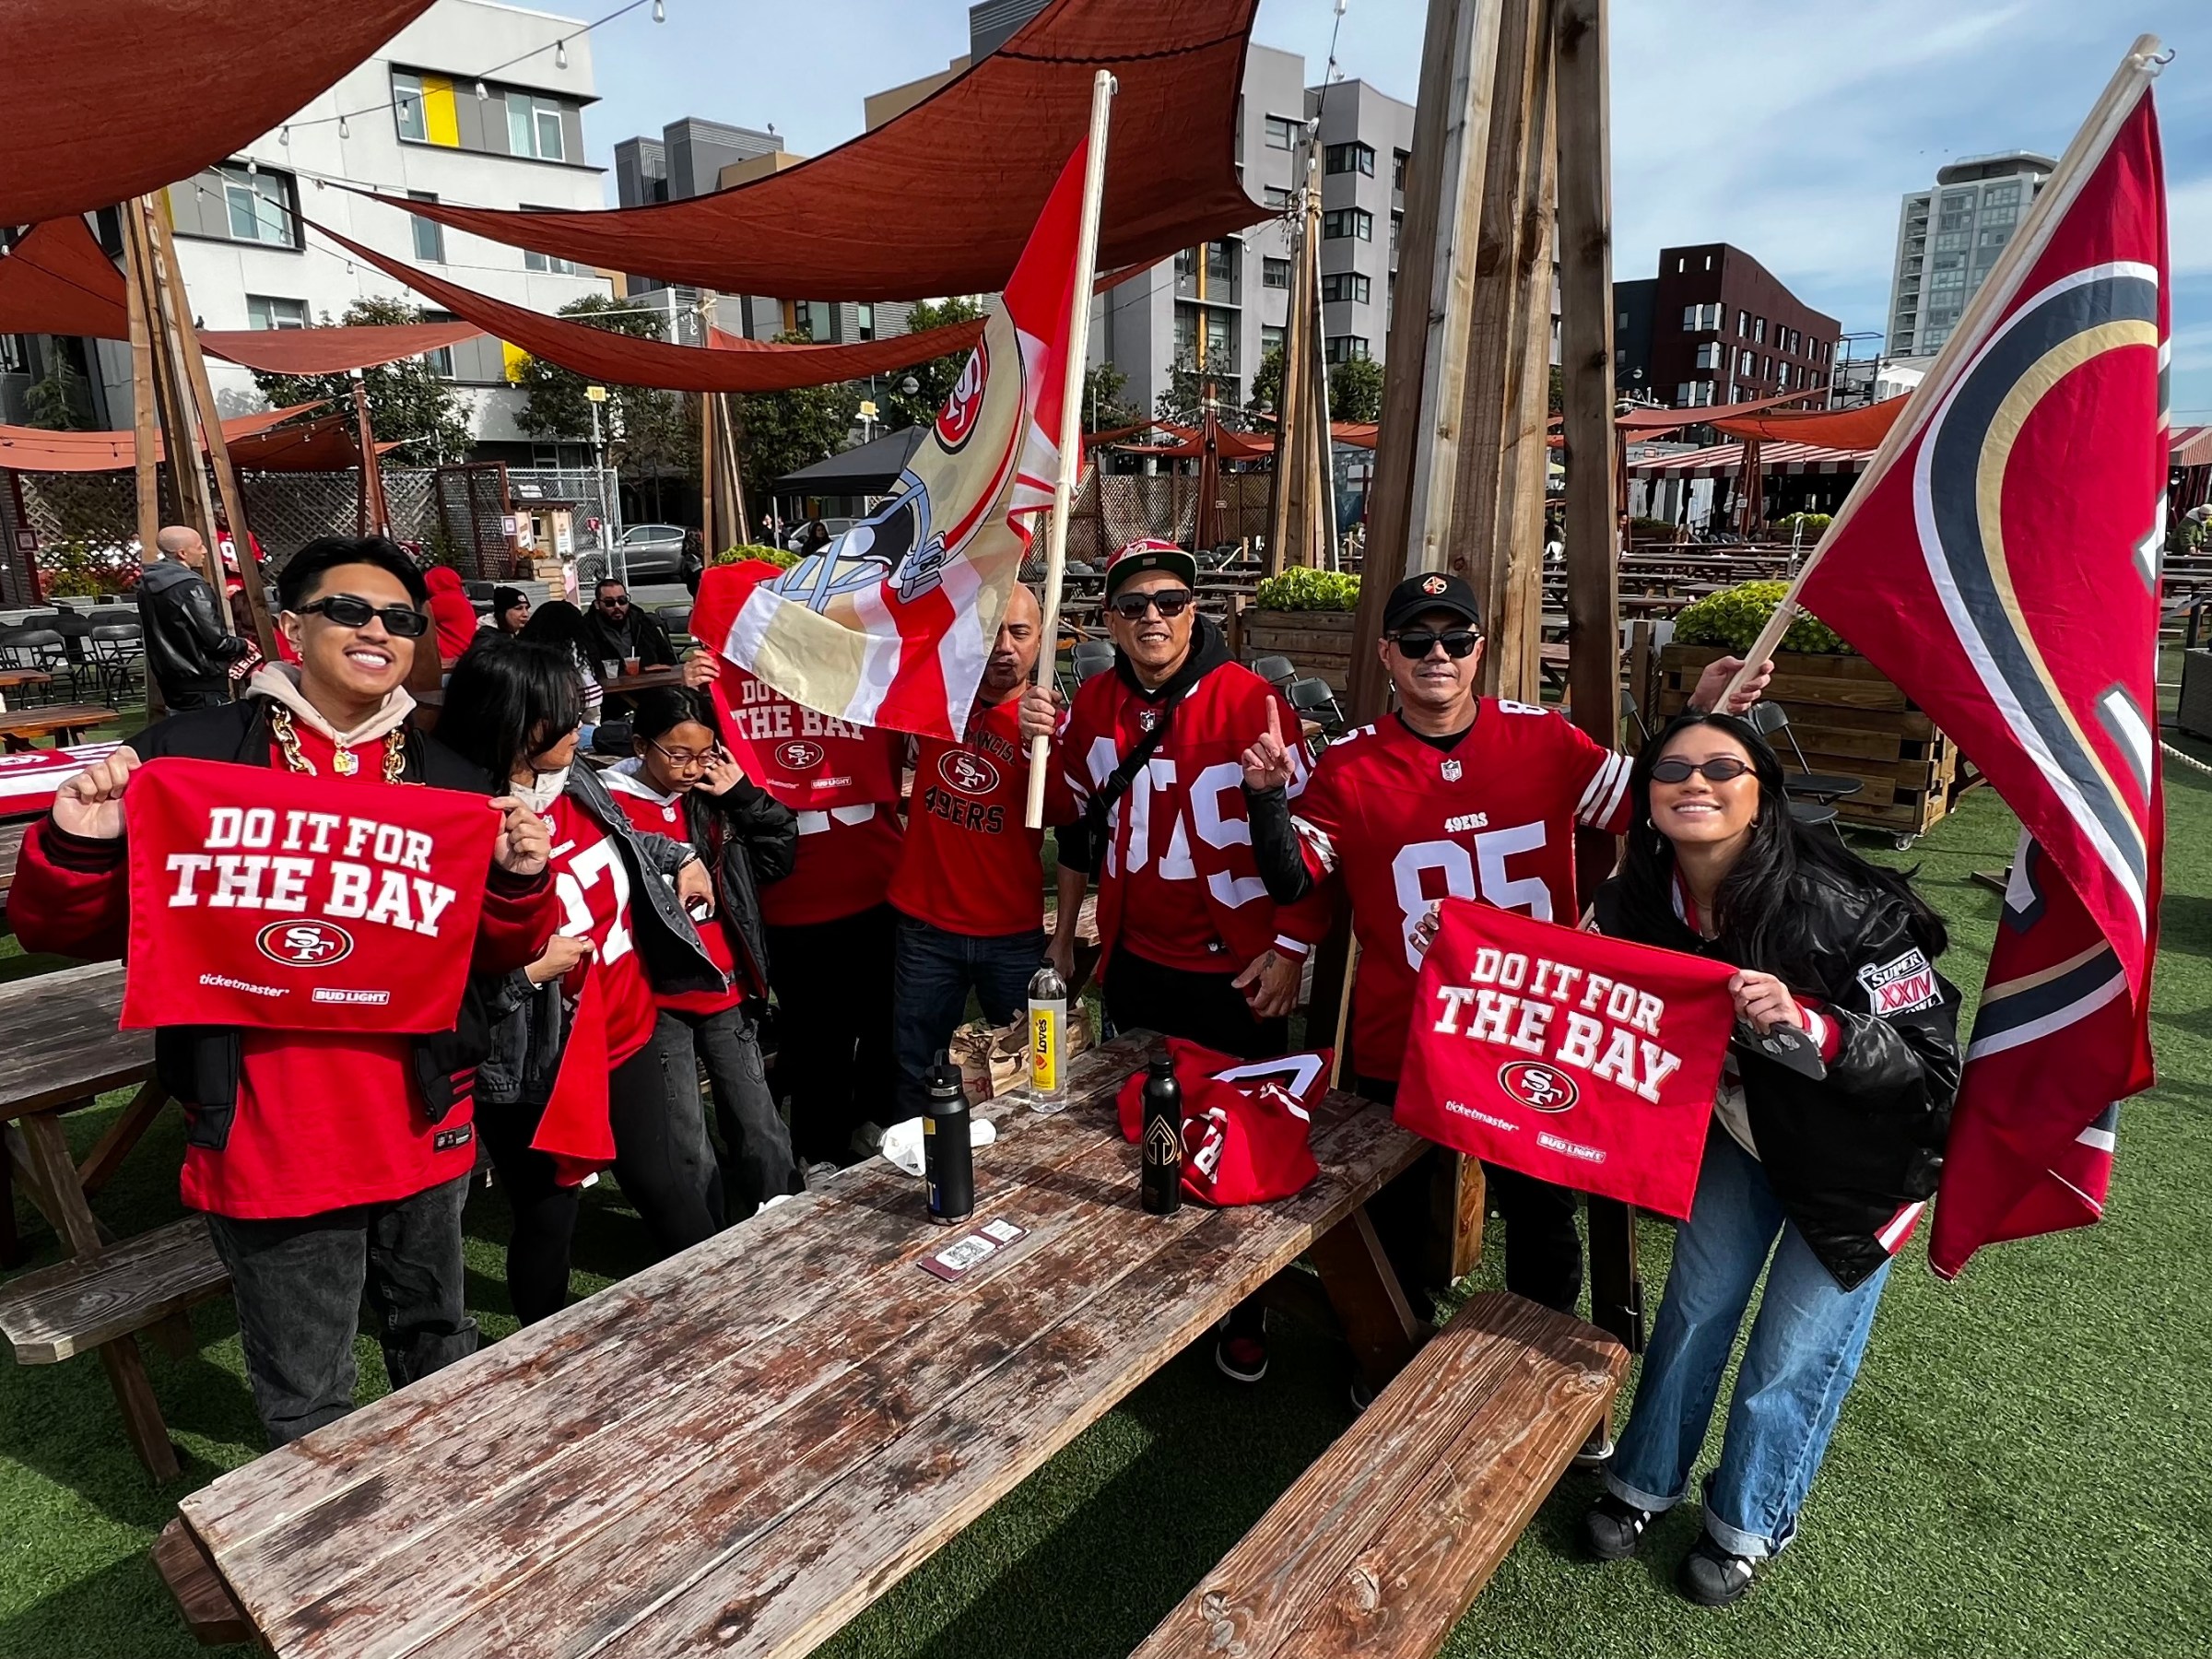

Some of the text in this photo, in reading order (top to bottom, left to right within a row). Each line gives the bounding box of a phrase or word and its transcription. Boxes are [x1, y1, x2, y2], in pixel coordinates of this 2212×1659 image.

[741, 679, 770, 704] DO
[730, 705, 794, 739] THE
[788, 745, 814, 765] SF
[955, 757, 986, 788] SF
[924, 783, 1006, 835] 49ERS
[1444, 812, 1488, 832] 49ERS
[204, 806, 434, 874] DO IT FOR
[166, 853, 457, 938] THE BAY
[1392, 820, 1554, 973] 85
[284, 927, 335, 961] SF
[199, 972, 286, 998] ticketmaster
[1871, 953, 1921, 988] SUPER
[315, 990, 387, 1004] BUD LIGHT
[1470, 947, 1665, 1038] DO IT FOR
[1878, 971, 1931, 1011] XXIV
[1433, 985, 1682, 1105] THE BAY
[1521, 1069, 1564, 1106] SF
[1446, 1100, 1516, 1133] ticketmaster
[1539, 1135, 1604, 1161] BUD LIGHT
